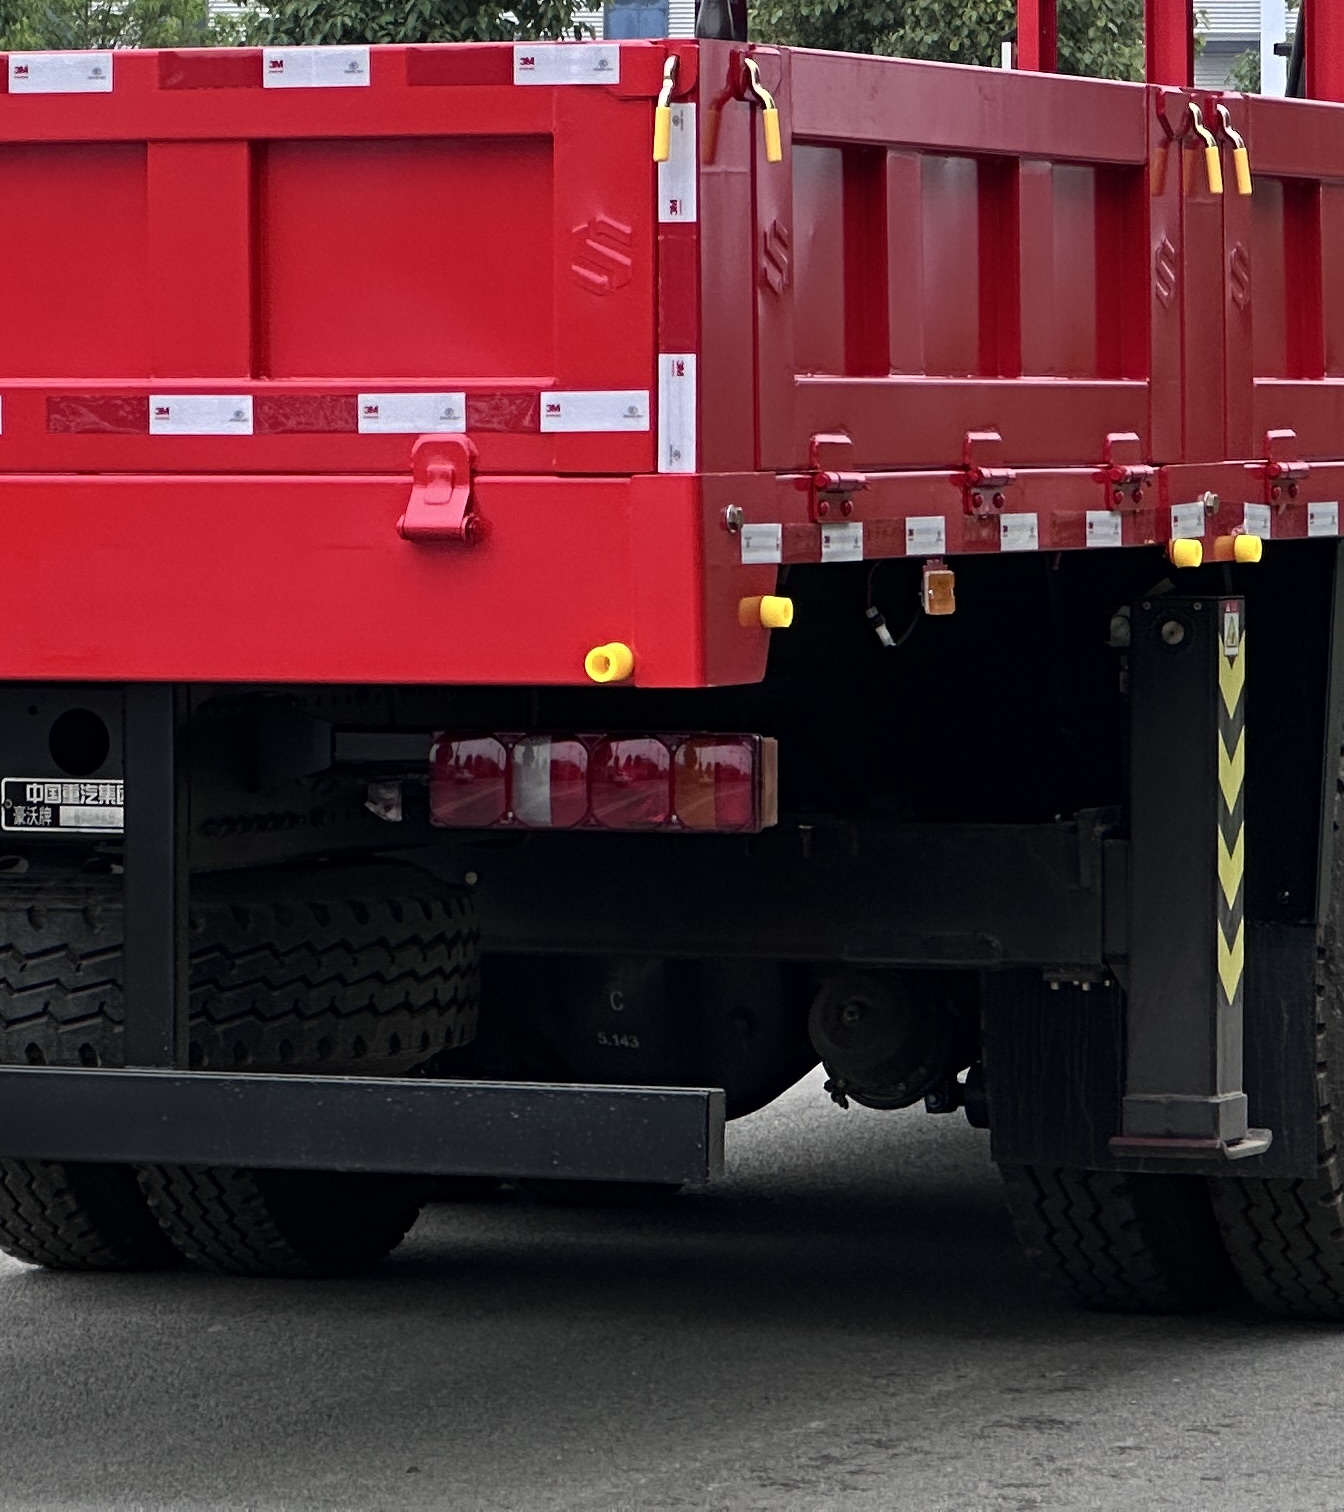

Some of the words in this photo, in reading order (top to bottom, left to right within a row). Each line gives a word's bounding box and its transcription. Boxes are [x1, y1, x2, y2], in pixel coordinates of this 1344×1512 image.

[12, 805, 53, 826] 豪沃牌
[597, 1031, 640, 1049] 5.143
